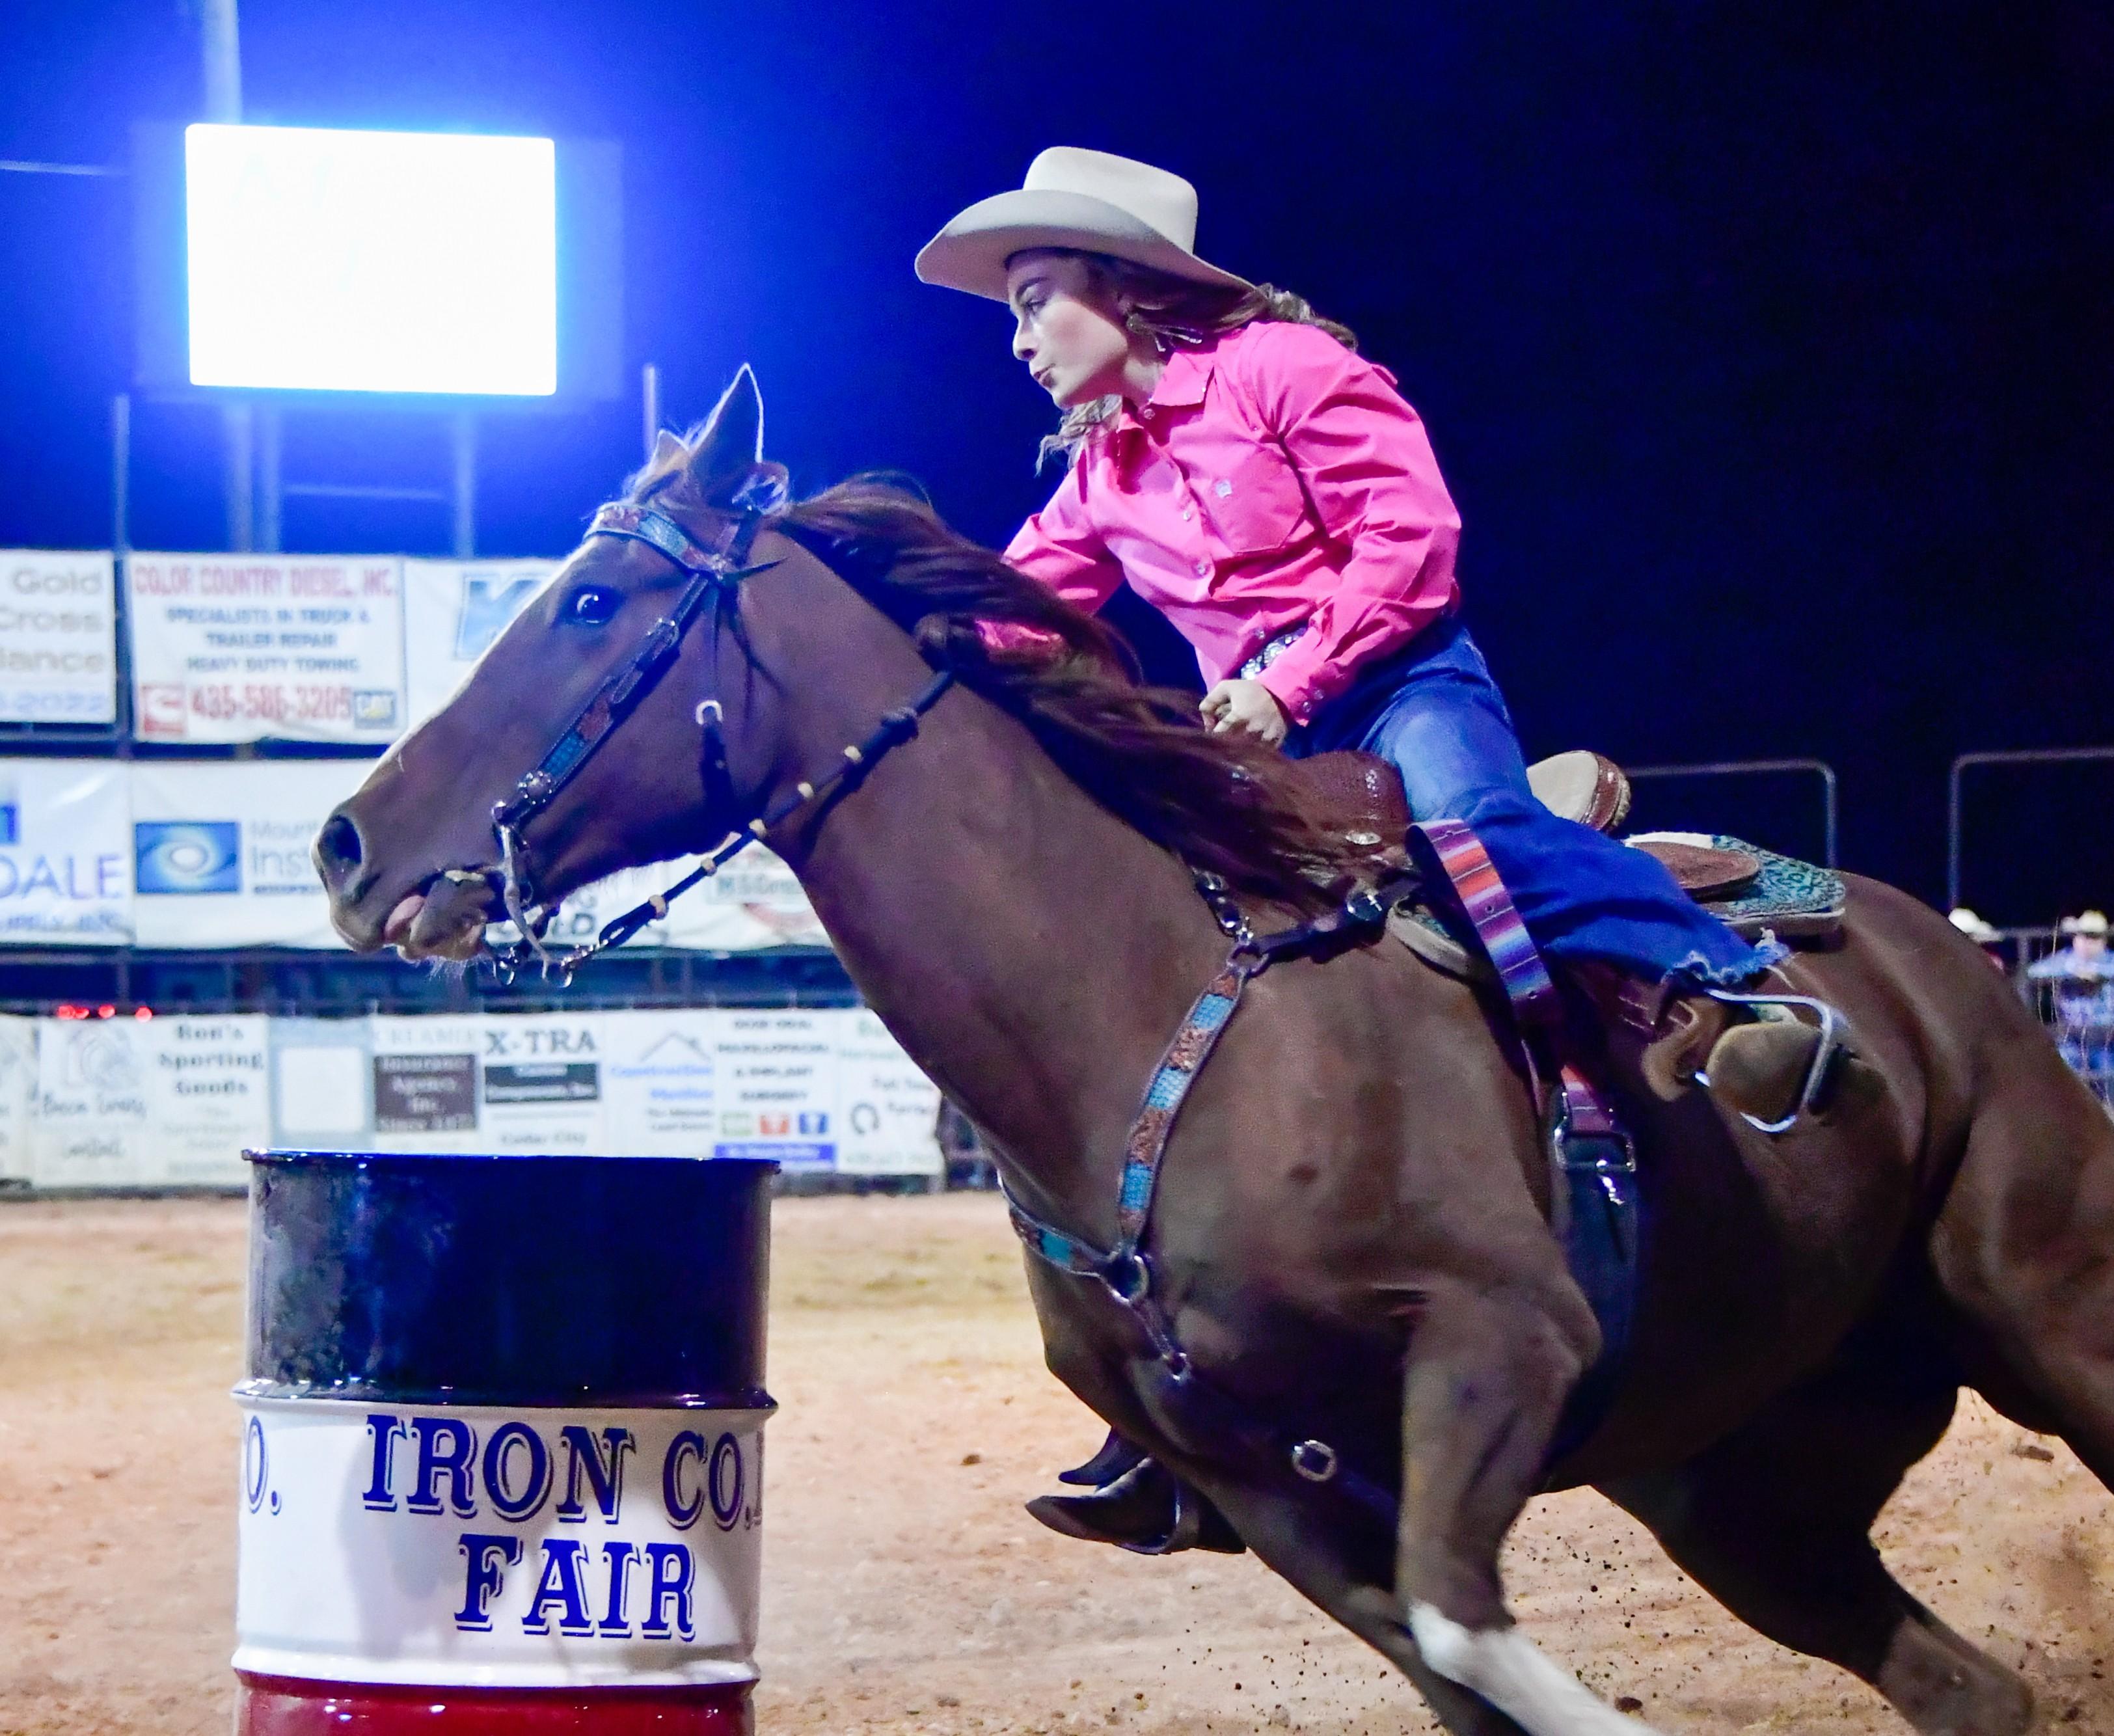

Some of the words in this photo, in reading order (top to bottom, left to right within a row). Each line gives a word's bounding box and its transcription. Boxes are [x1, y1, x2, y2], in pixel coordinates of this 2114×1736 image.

[12, 568, 102, 595] Gold
[362, 1414, 634, 1525] IRON
[663, 1430, 750, 1531] CO.
[454, 1534, 696, 1642] FAIR
